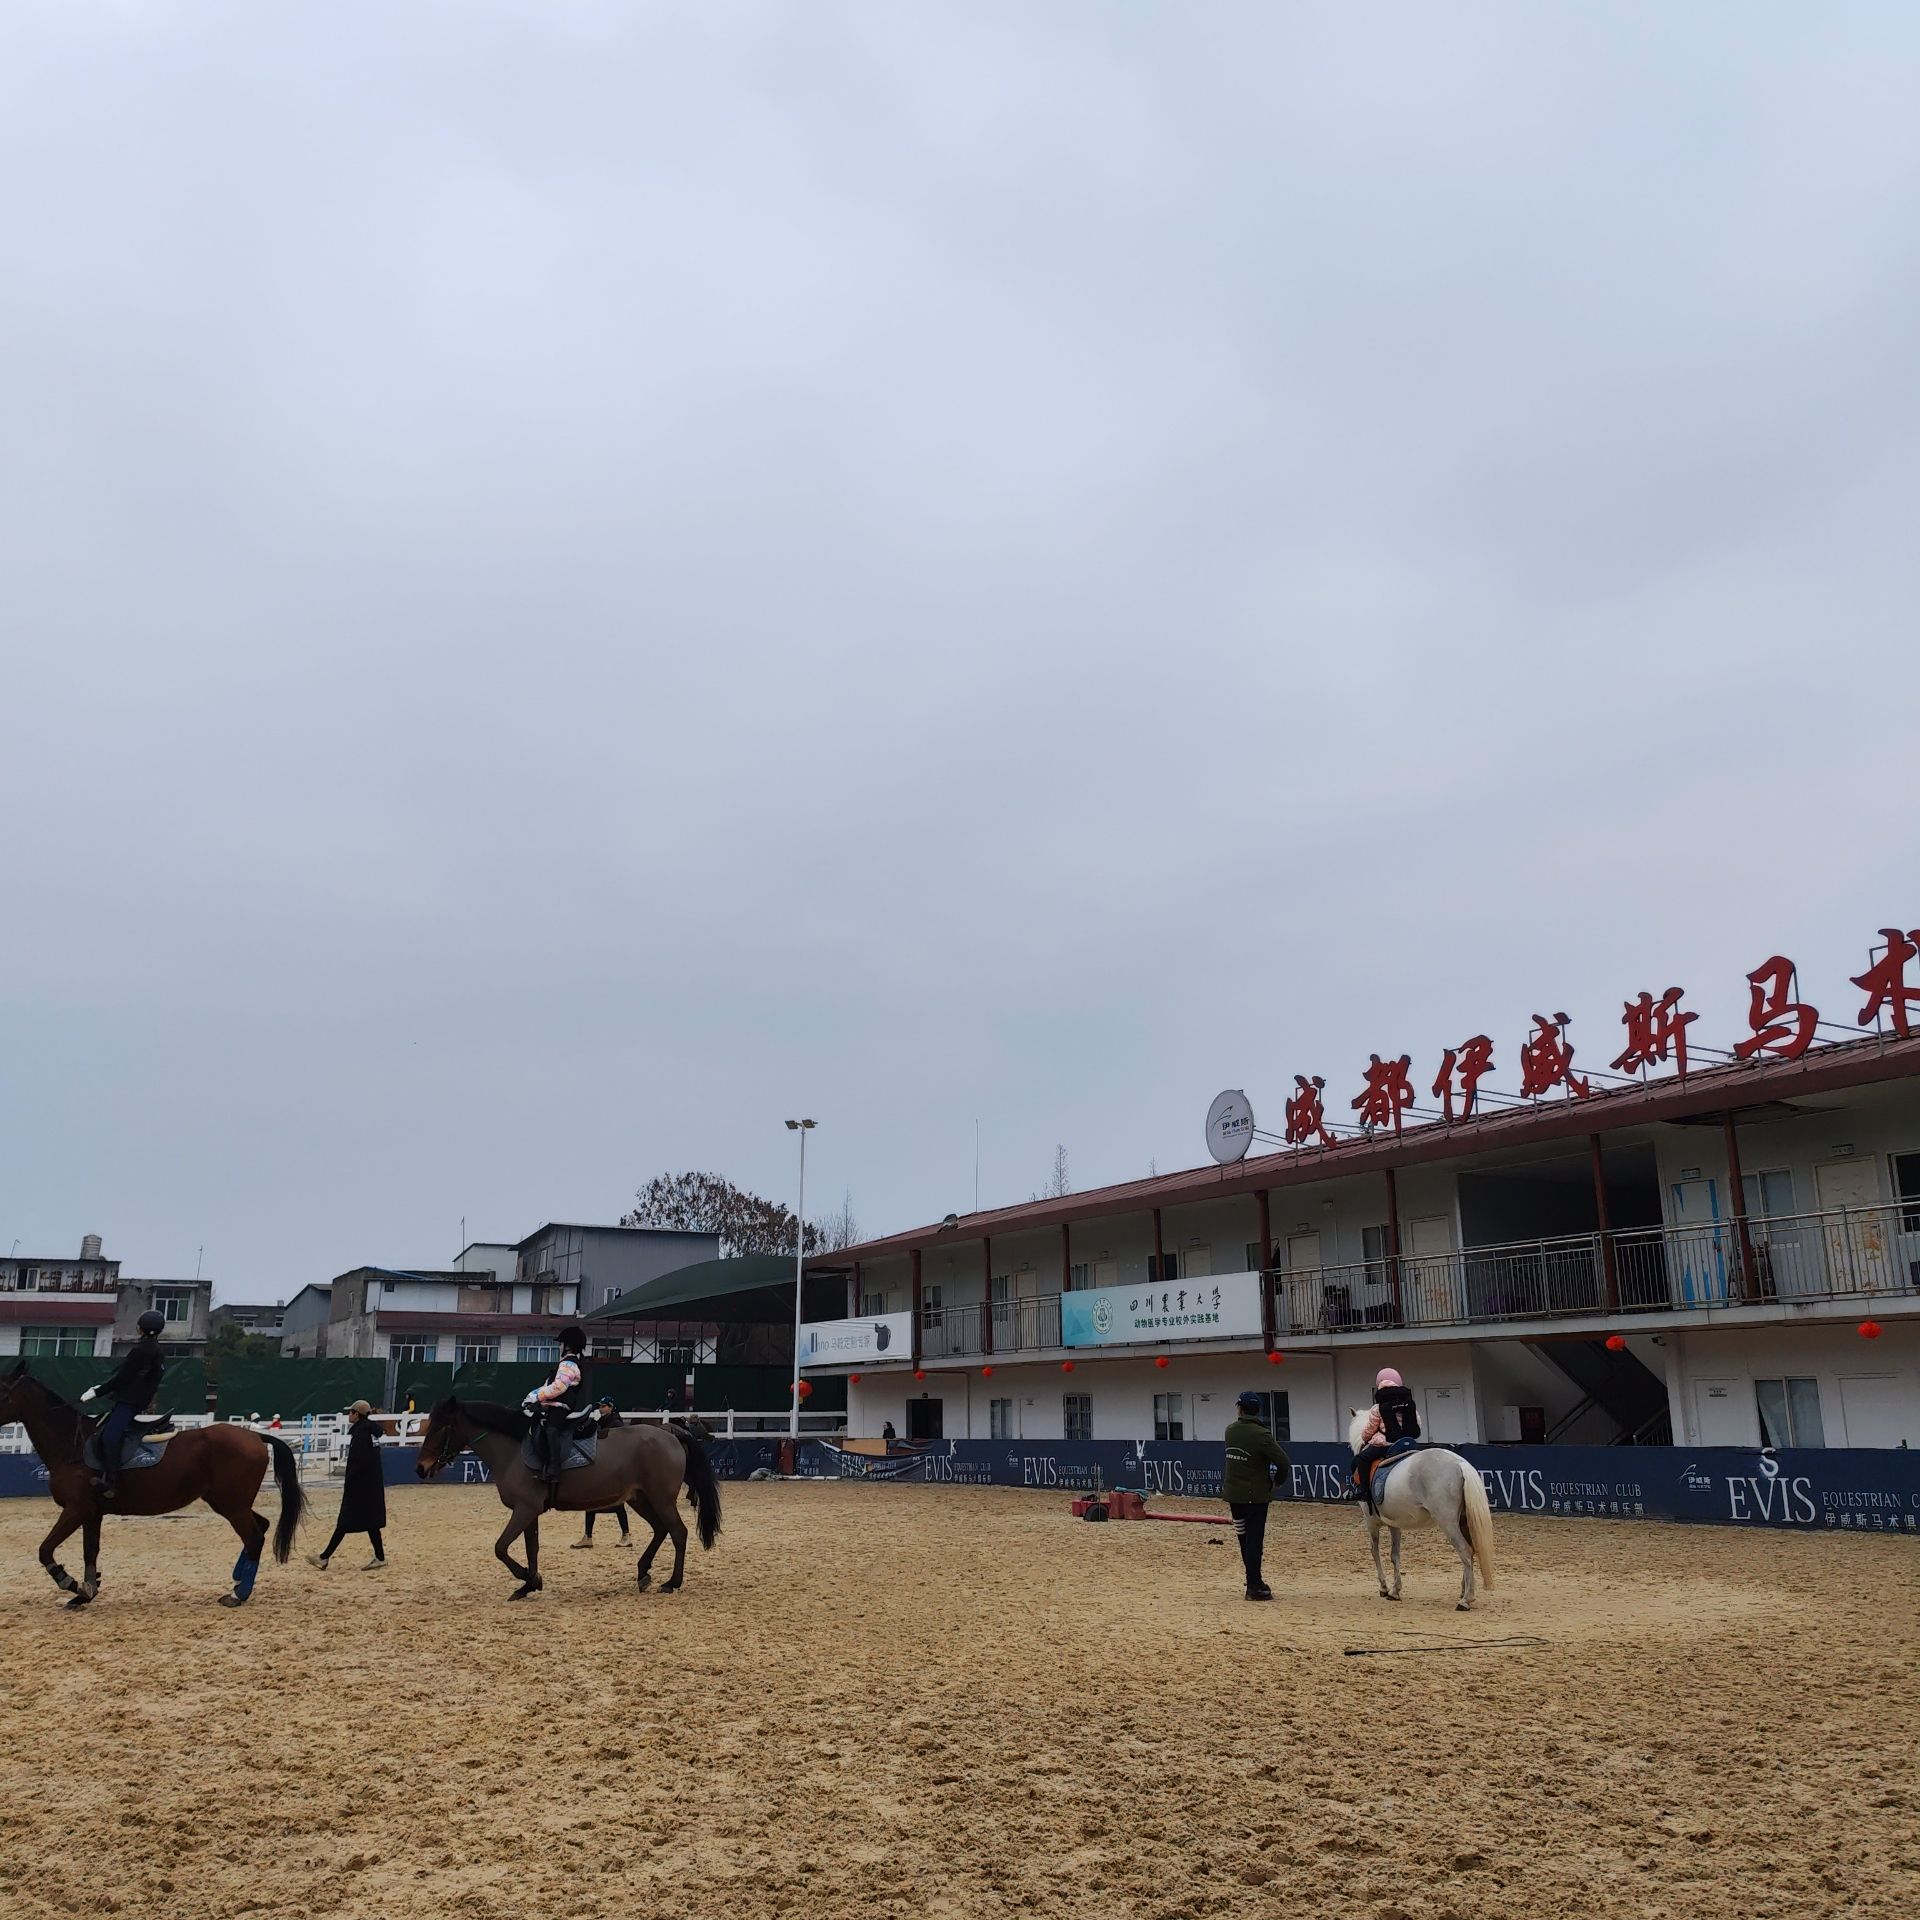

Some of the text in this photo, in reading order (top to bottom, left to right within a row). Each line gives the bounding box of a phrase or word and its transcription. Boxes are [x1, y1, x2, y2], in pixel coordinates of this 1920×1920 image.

[463, 1461, 490, 1483] EV
[925, 1455, 953, 1481] EVIS
[1023, 1457, 1057, 1485] EVIS
[1142, 1460, 1184, 1491] EVIS
[1186, 1470, 1222, 1481] EQUESTRIAN
[1290, 1464, 1342, 1499] EVIS
[1477, 1470, 1642, 1510] EVIS EQUESTRIAN CLUB
[1725, 1477, 1816, 1522] EVIS
[1822, 1491, 1901, 1509] EQUESTRIAN
[1551, 1500, 1644, 1516] 伊威斯马术俱乐部
[1824, 1512, 1917, 1529] 伊威斯马术俱
